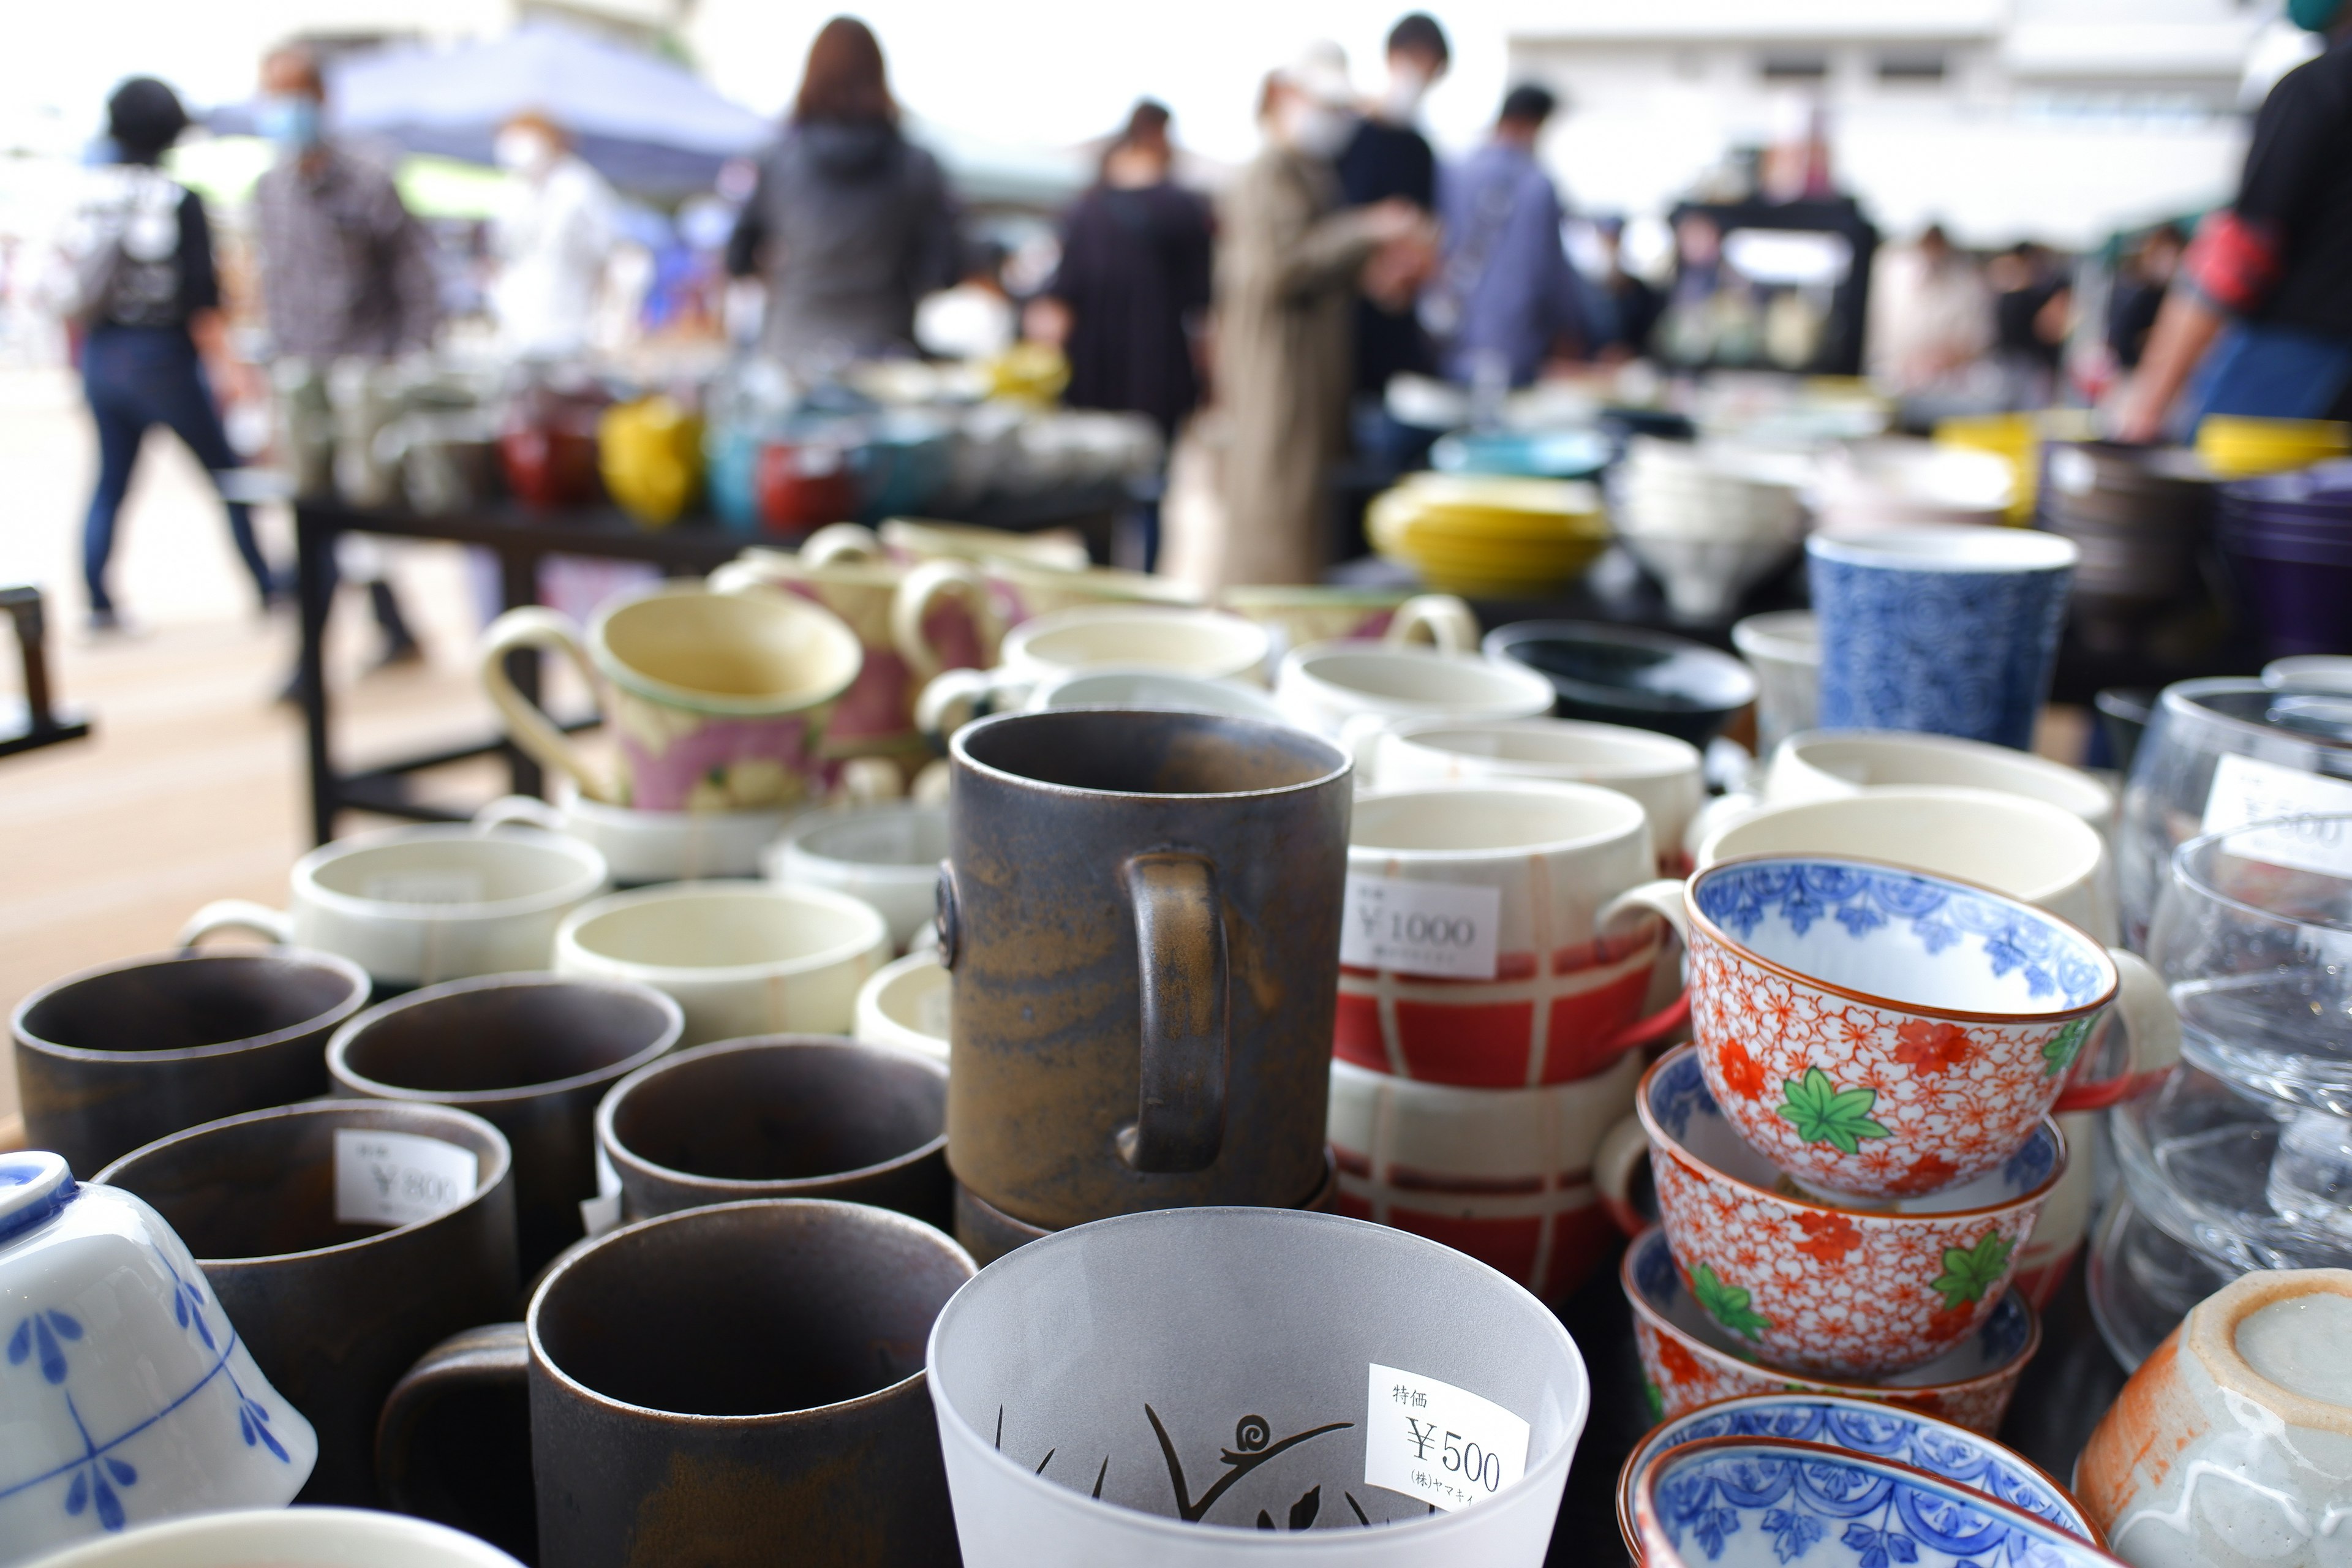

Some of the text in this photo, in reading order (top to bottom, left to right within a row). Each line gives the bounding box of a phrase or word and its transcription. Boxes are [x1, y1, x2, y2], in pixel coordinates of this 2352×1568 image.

[1359, 905, 1476, 950] ¥1000
[1392, 1384, 1427, 1408] 特価
[1405, 1416, 1500, 1492] ¥500
[1411, 1469, 1482, 1506] (株)ヤマキイ
